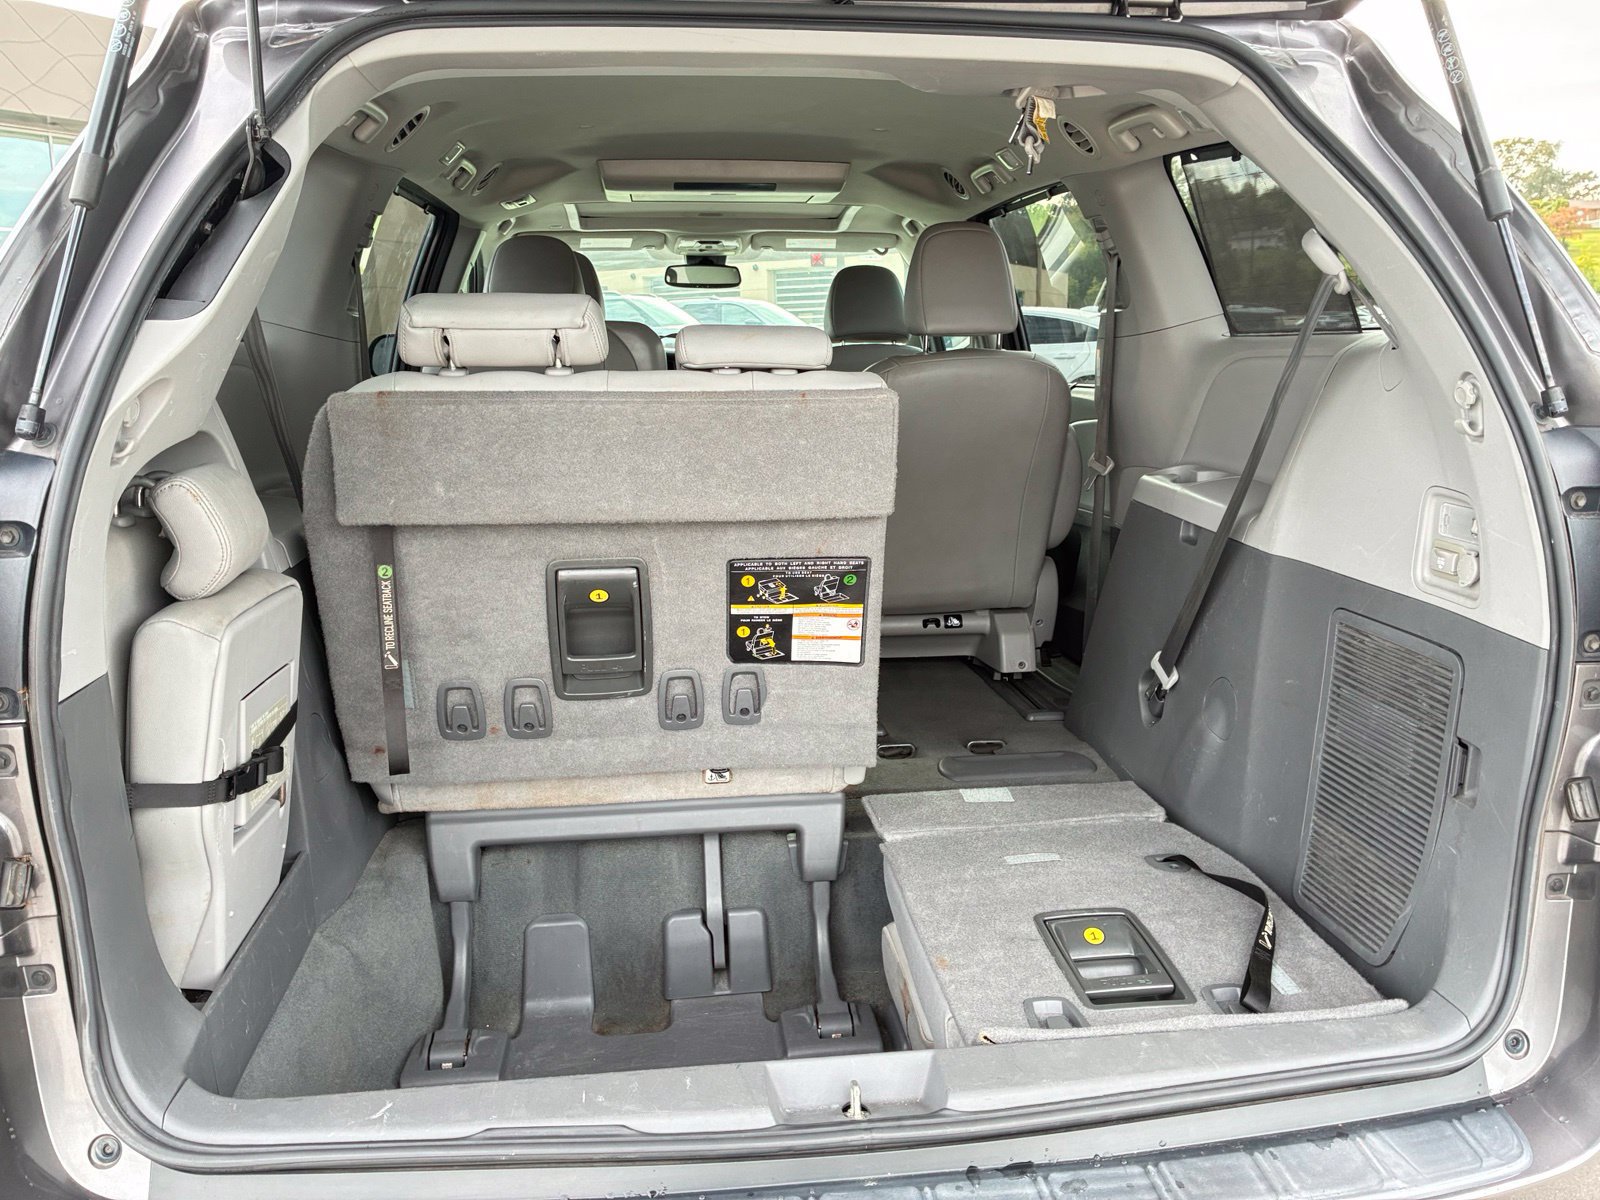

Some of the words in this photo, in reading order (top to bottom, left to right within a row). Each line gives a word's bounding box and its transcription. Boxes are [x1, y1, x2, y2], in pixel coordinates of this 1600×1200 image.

[381, 580, 393, 614] SEATBACK
[384, 614, 394, 641] RECLINE
[386, 642, 395, 650] TO
